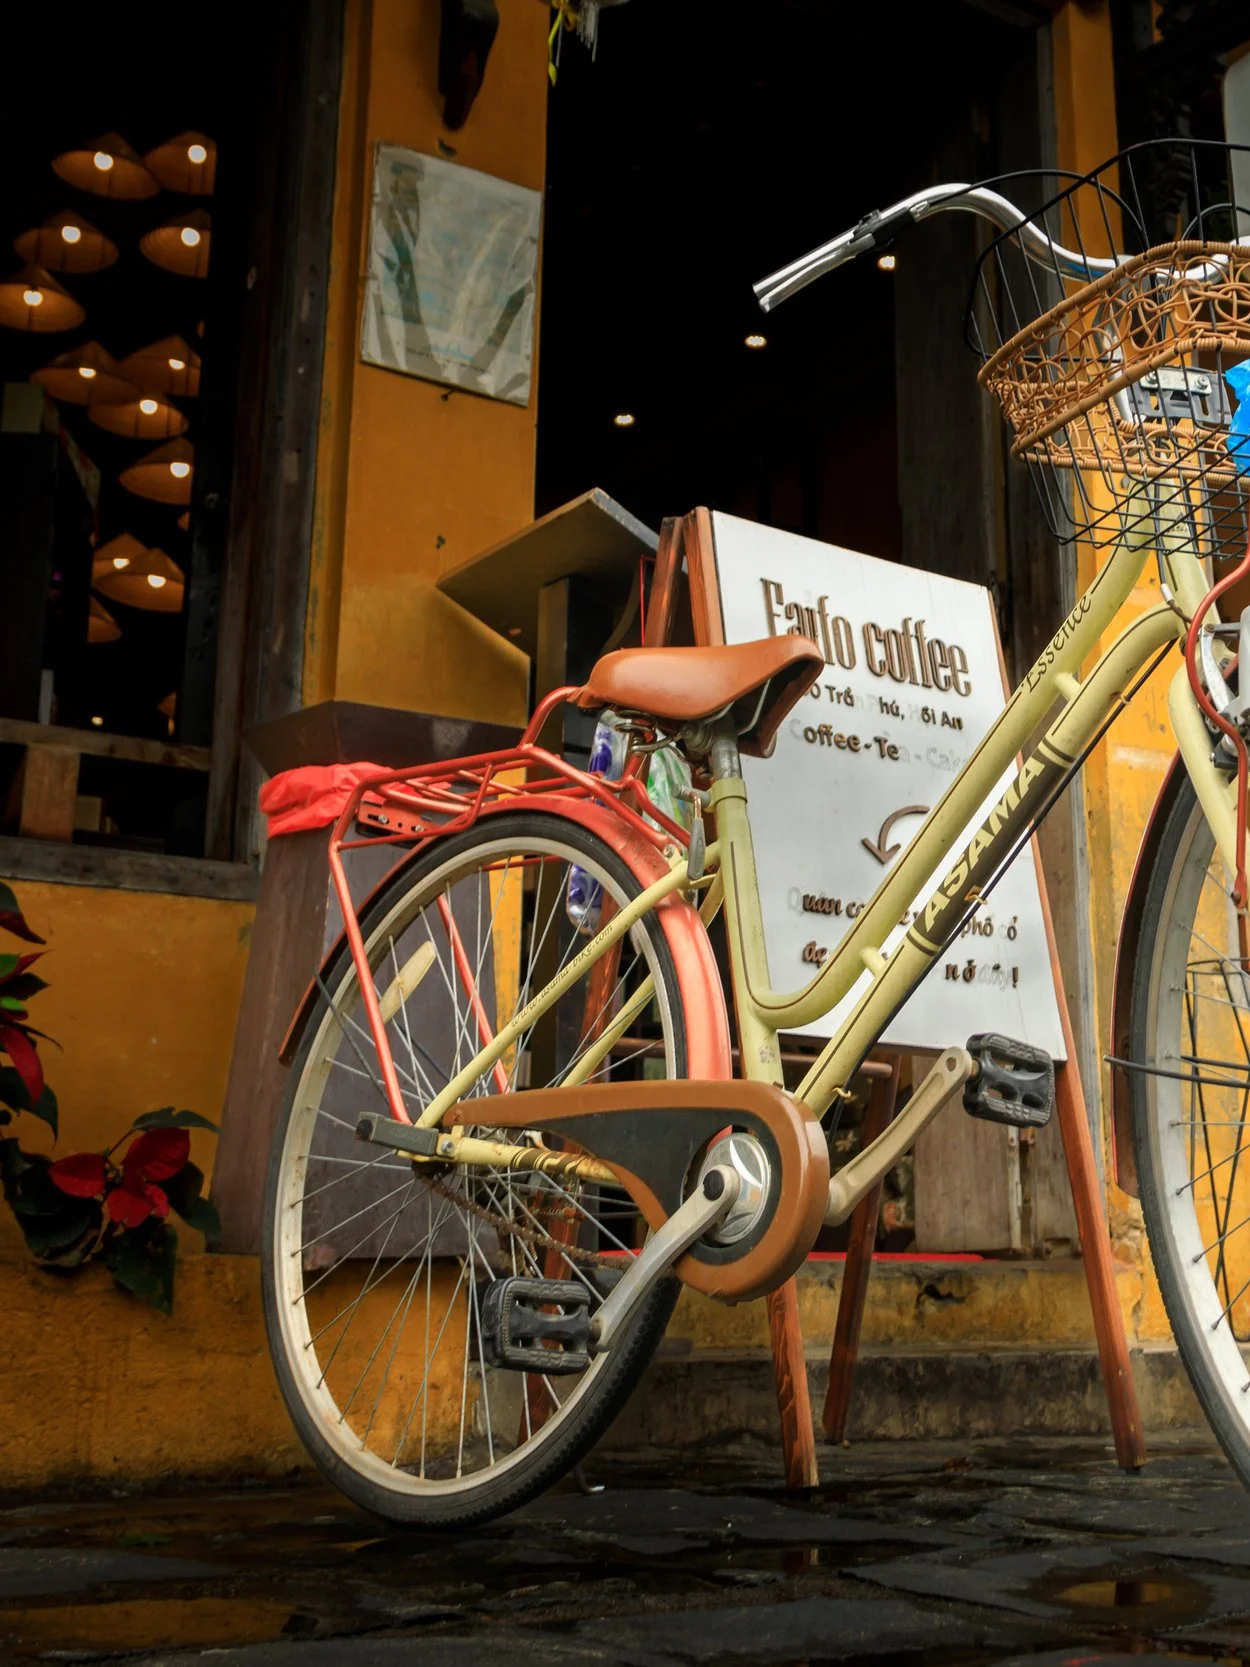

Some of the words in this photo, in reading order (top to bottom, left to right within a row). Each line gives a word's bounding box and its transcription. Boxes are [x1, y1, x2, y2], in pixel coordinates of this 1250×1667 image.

[862, 616, 972, 697] coffee
[1026, 595, 1092, 693] Essence
[941, 711, 964, 731] An
[925, 756, 1045, 932] ASAMA
